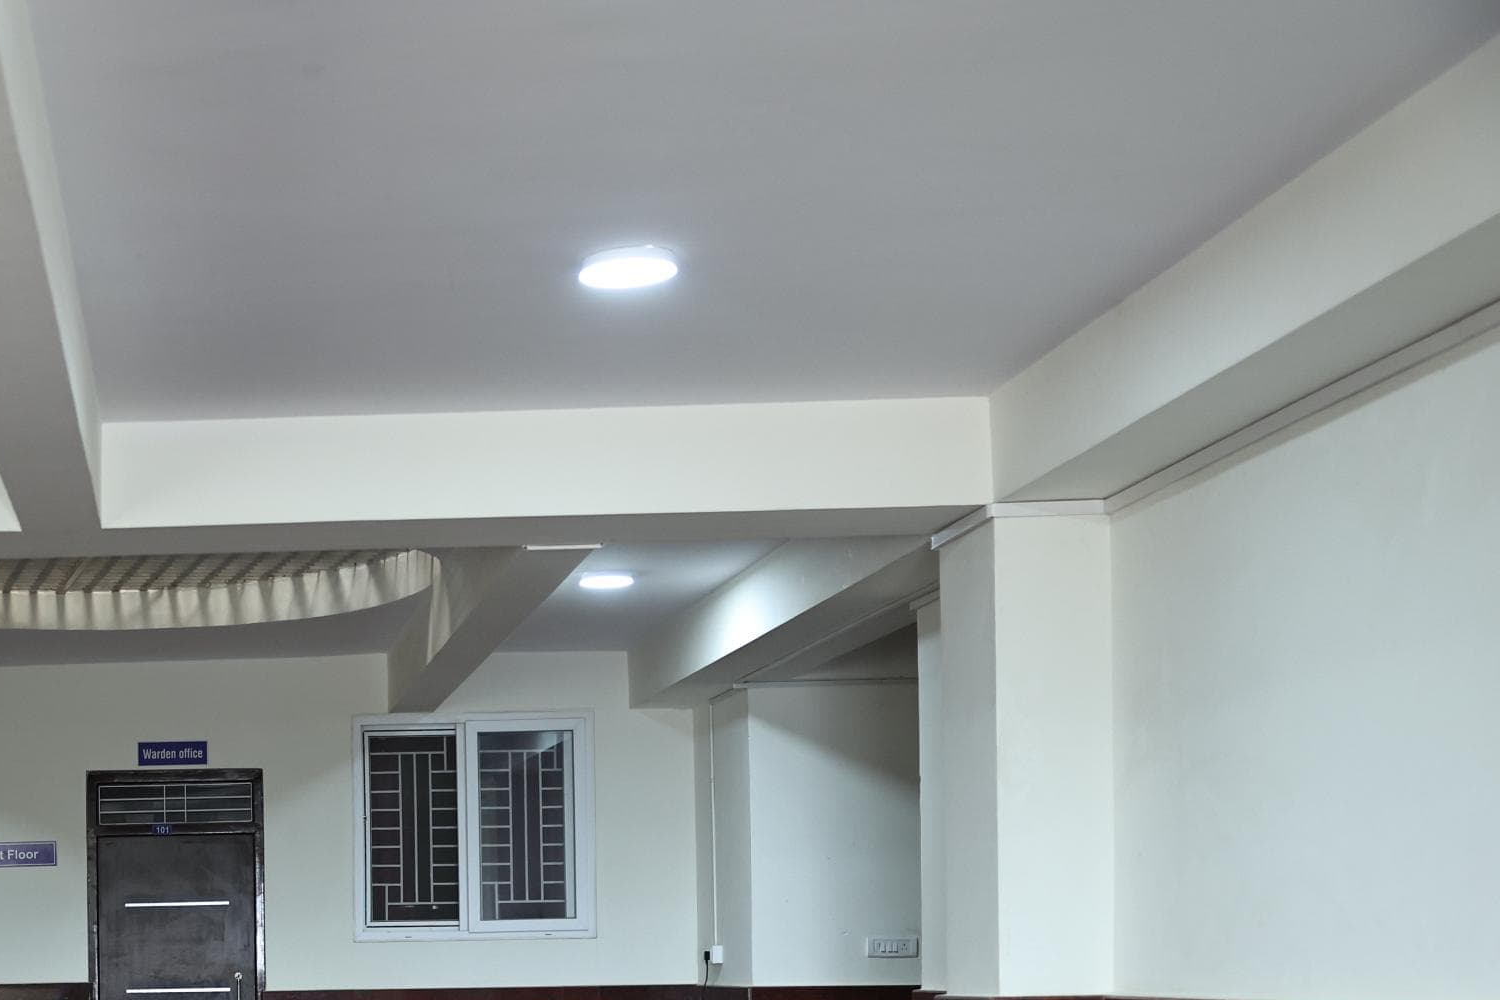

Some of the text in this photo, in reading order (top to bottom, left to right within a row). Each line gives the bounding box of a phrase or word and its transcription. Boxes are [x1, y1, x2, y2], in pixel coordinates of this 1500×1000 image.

[143, 748, 204, 760] Warden office
[155, 826, 170, 834] 101
[7, 849, 39, 860] Floor
